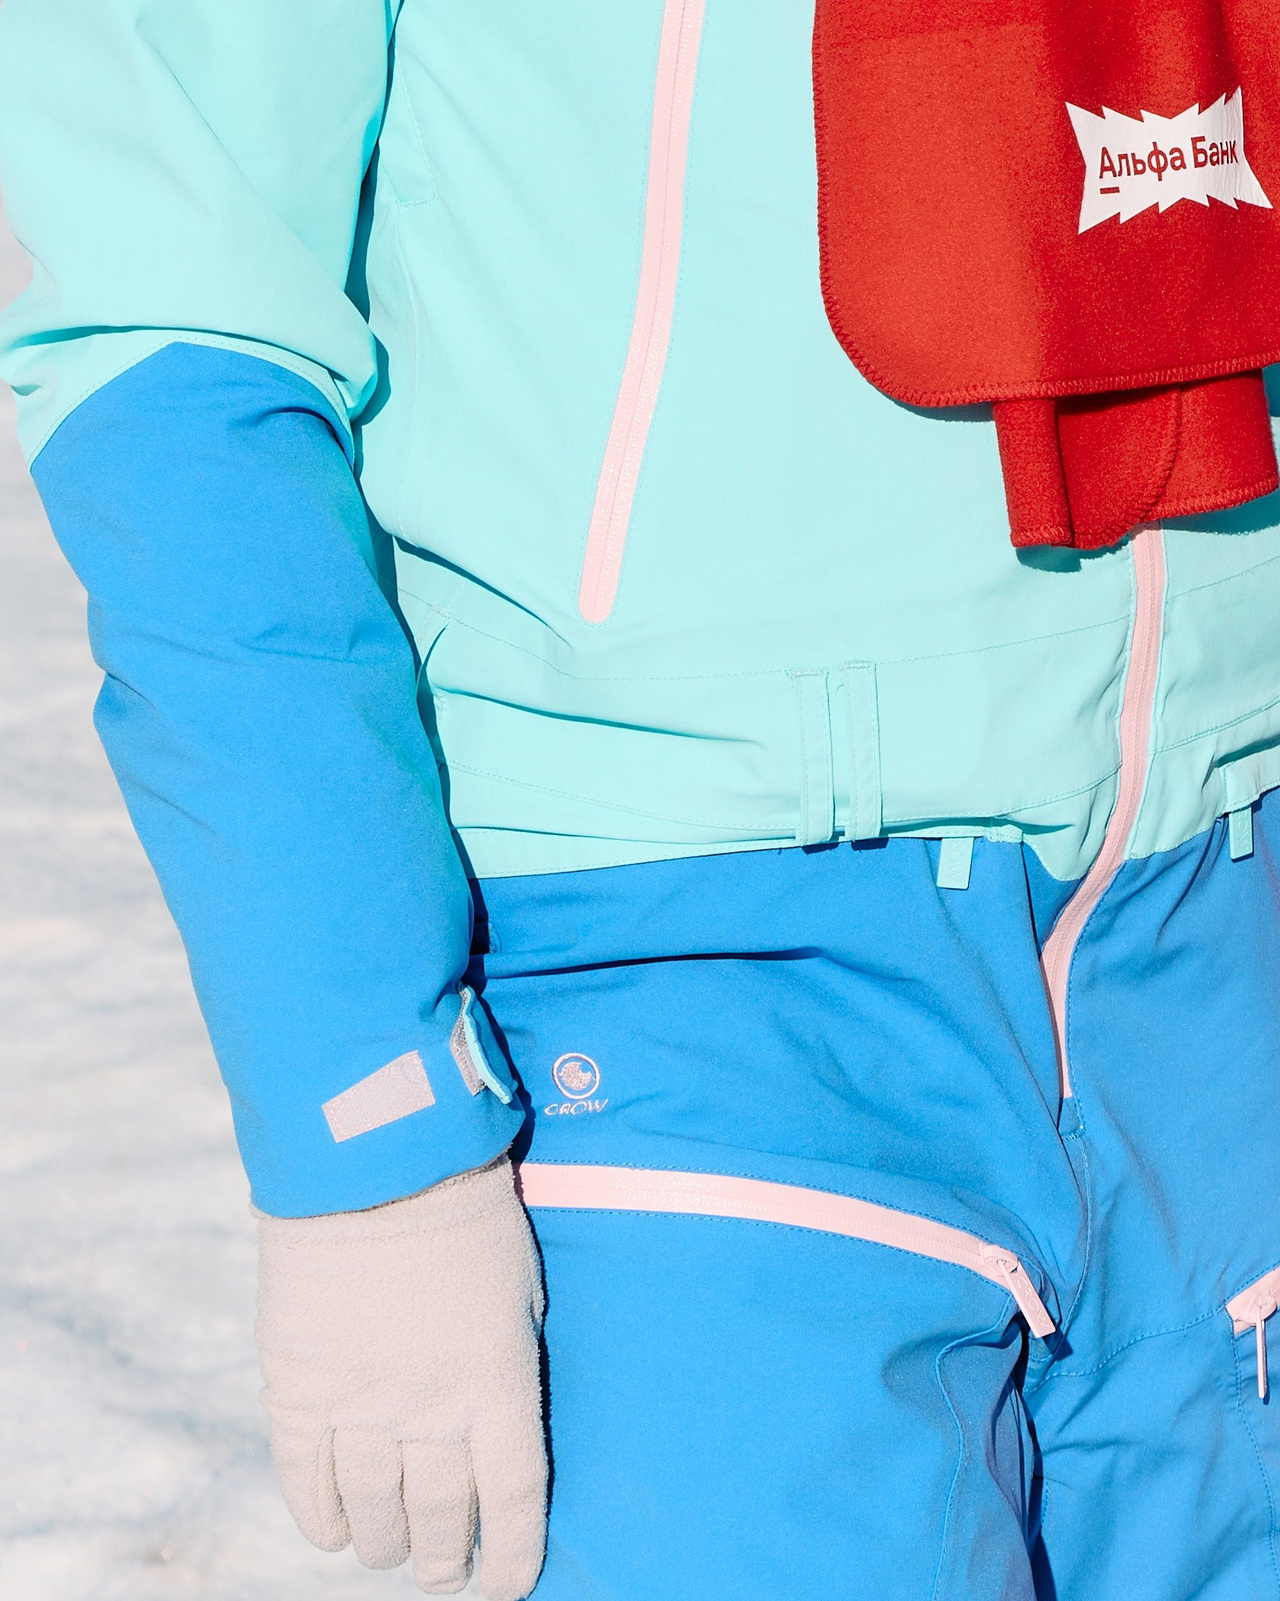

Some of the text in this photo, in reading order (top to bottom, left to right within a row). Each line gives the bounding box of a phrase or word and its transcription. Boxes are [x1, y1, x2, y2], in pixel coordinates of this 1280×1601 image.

[1098, 135, 1239, 182] Альфа Банк
[543, 1098, 609, 1116] CROW
